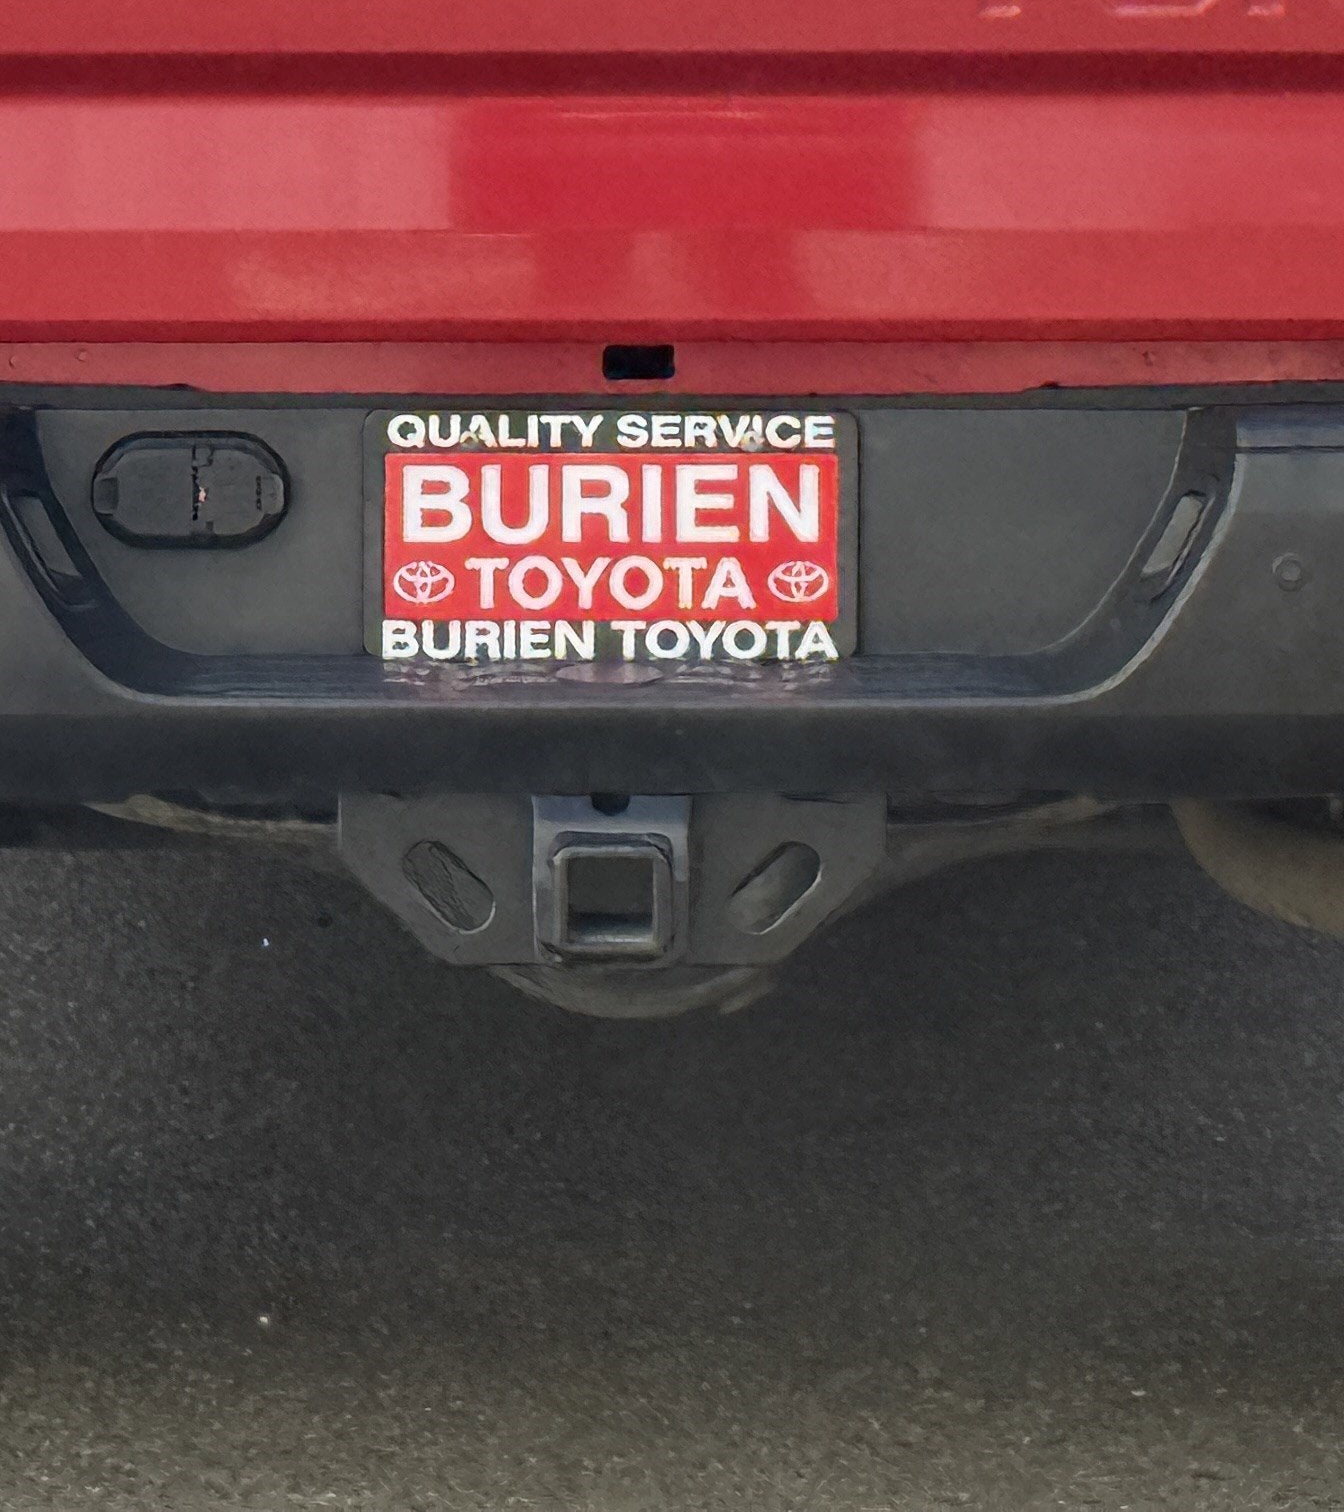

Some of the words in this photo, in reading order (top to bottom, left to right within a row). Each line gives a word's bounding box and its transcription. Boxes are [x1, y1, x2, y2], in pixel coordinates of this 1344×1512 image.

[387, 414, 603, 448] QUALITY
[616, 414, 835, 448] SERVICE
[402, 464, 819, 543] BURIEN
[465, 555, 757, 610] TOYOTA
[382, 620, 594, 660] BURIEN
[611, 620, 838, 660] TOYOTA
